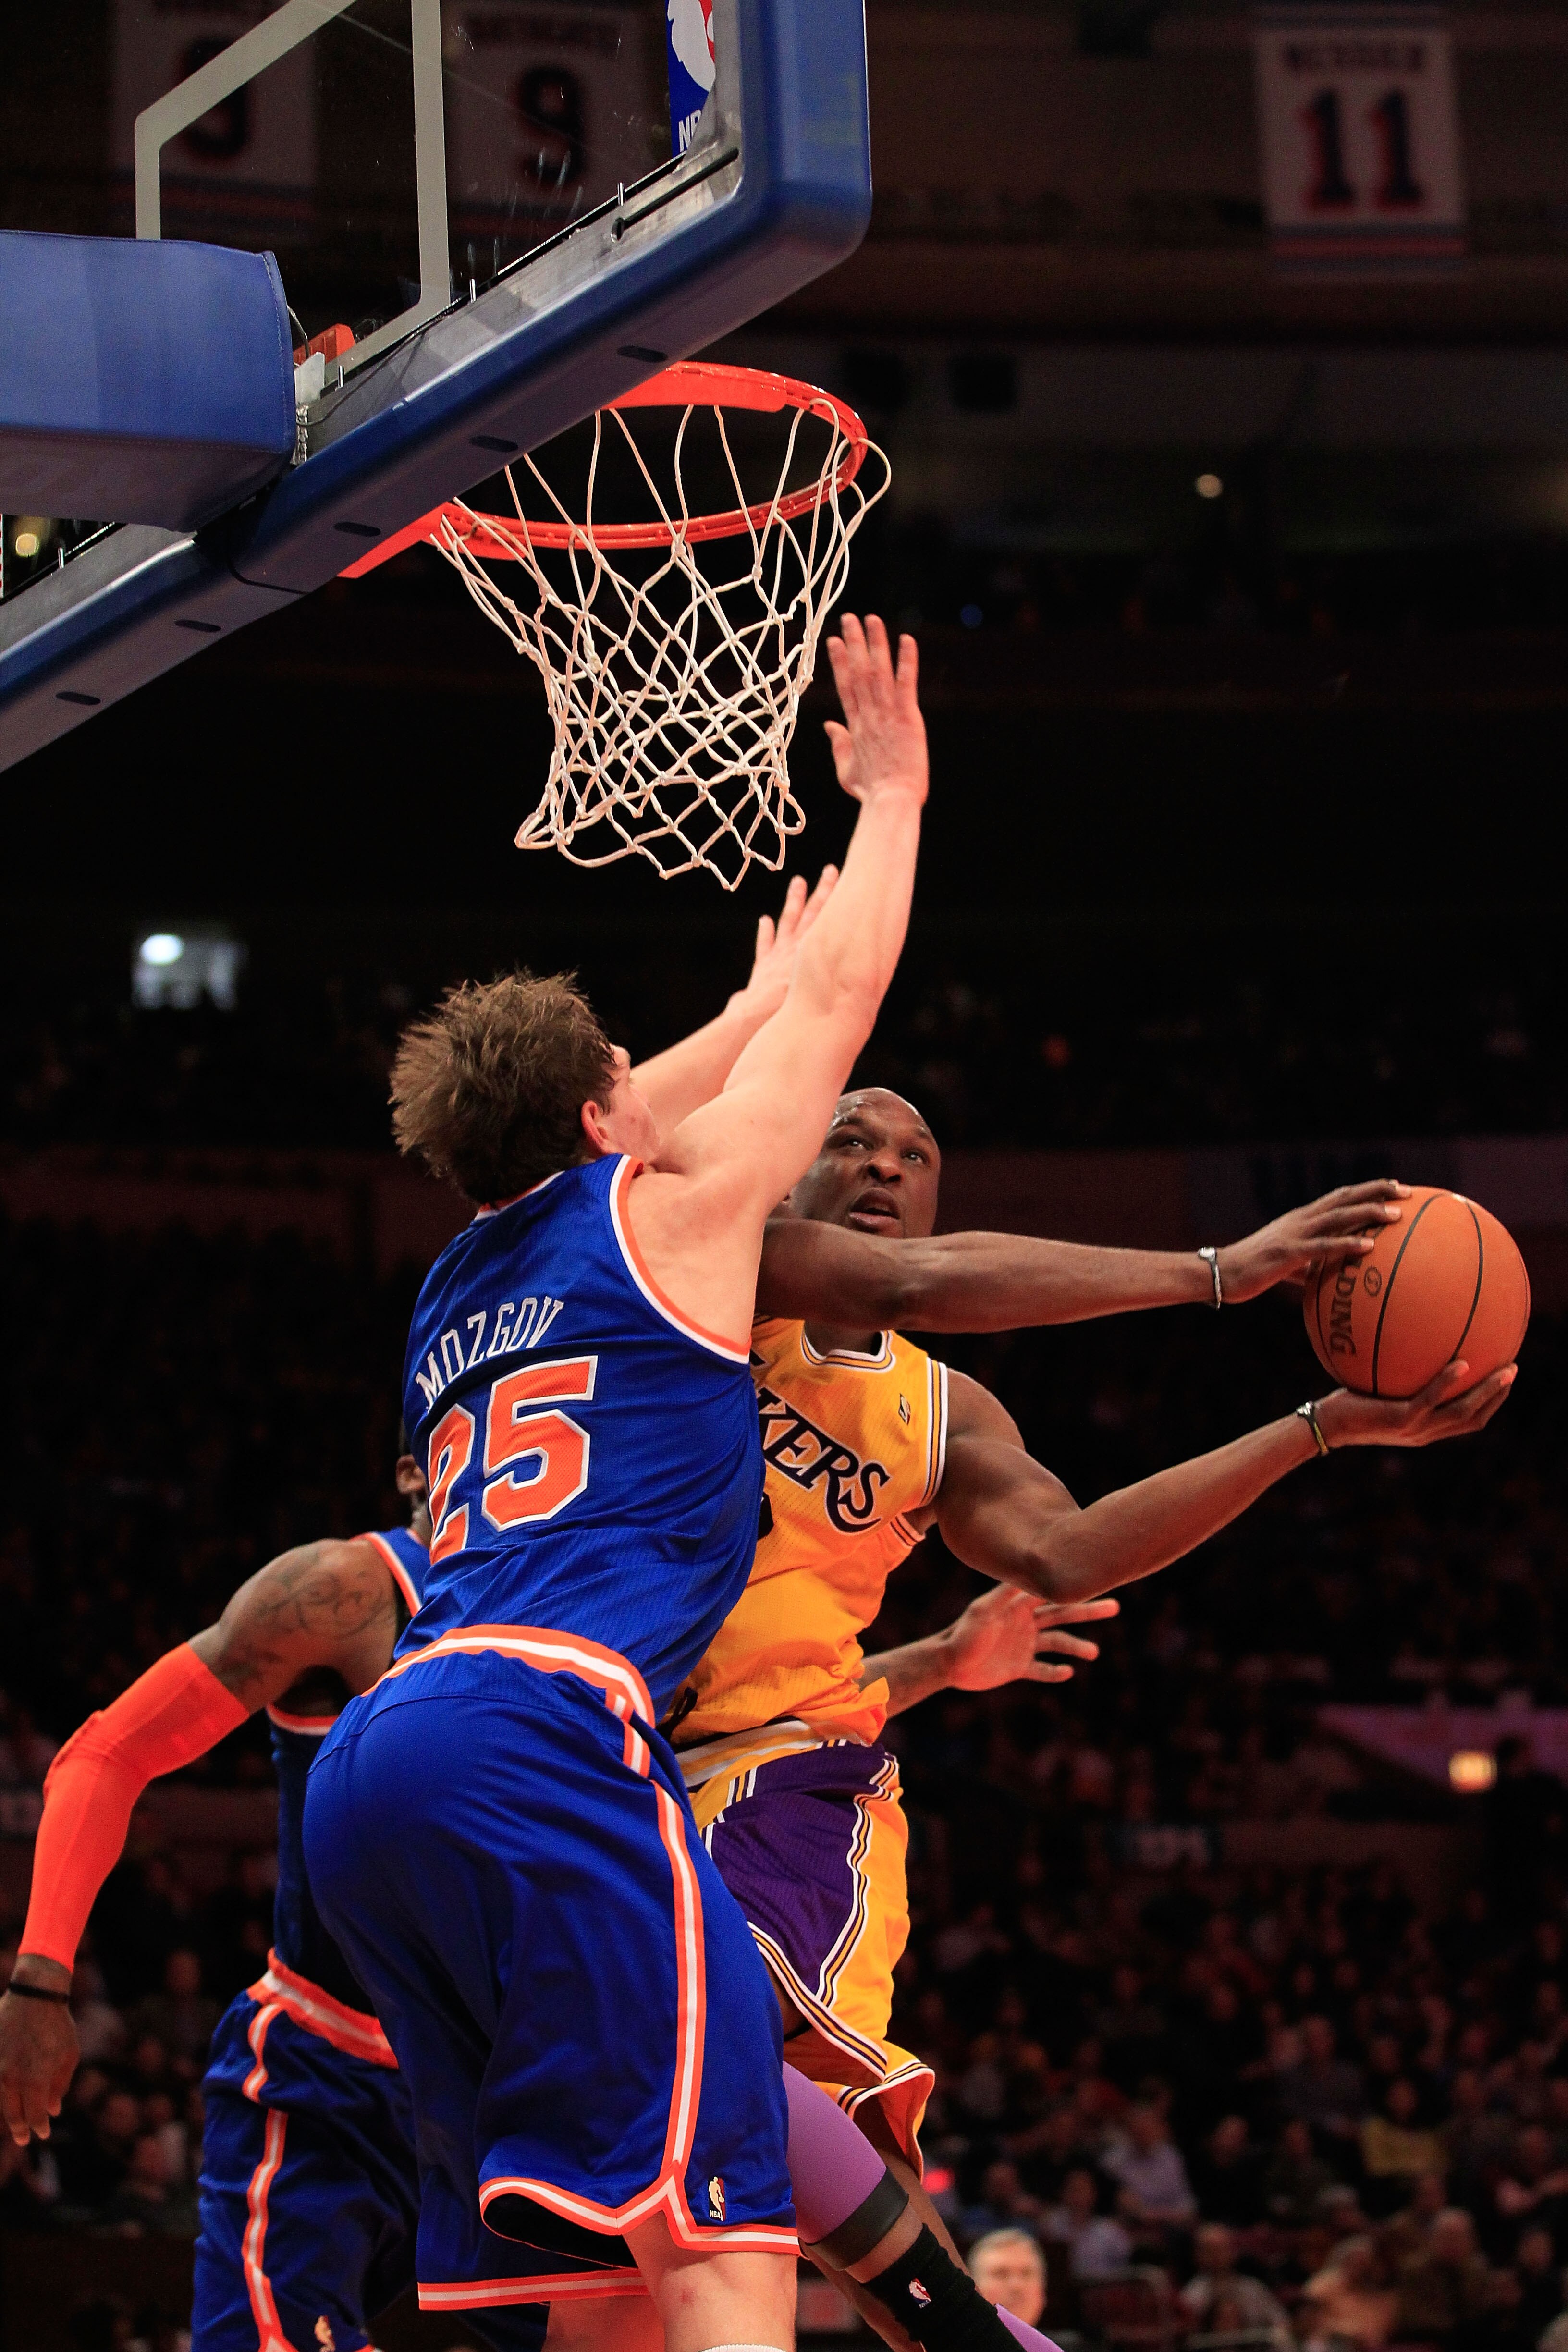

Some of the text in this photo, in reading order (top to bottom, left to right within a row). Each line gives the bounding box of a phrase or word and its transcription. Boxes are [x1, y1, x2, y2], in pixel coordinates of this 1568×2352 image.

[515, 63, 585, 186] 9
[1299, 87, 1426, 211] 11
[415, 1296, 564, 1409] MOZGOV
[429, 1355, 599, 1565] 25
[709, 2210, 721, 2219] NBA
